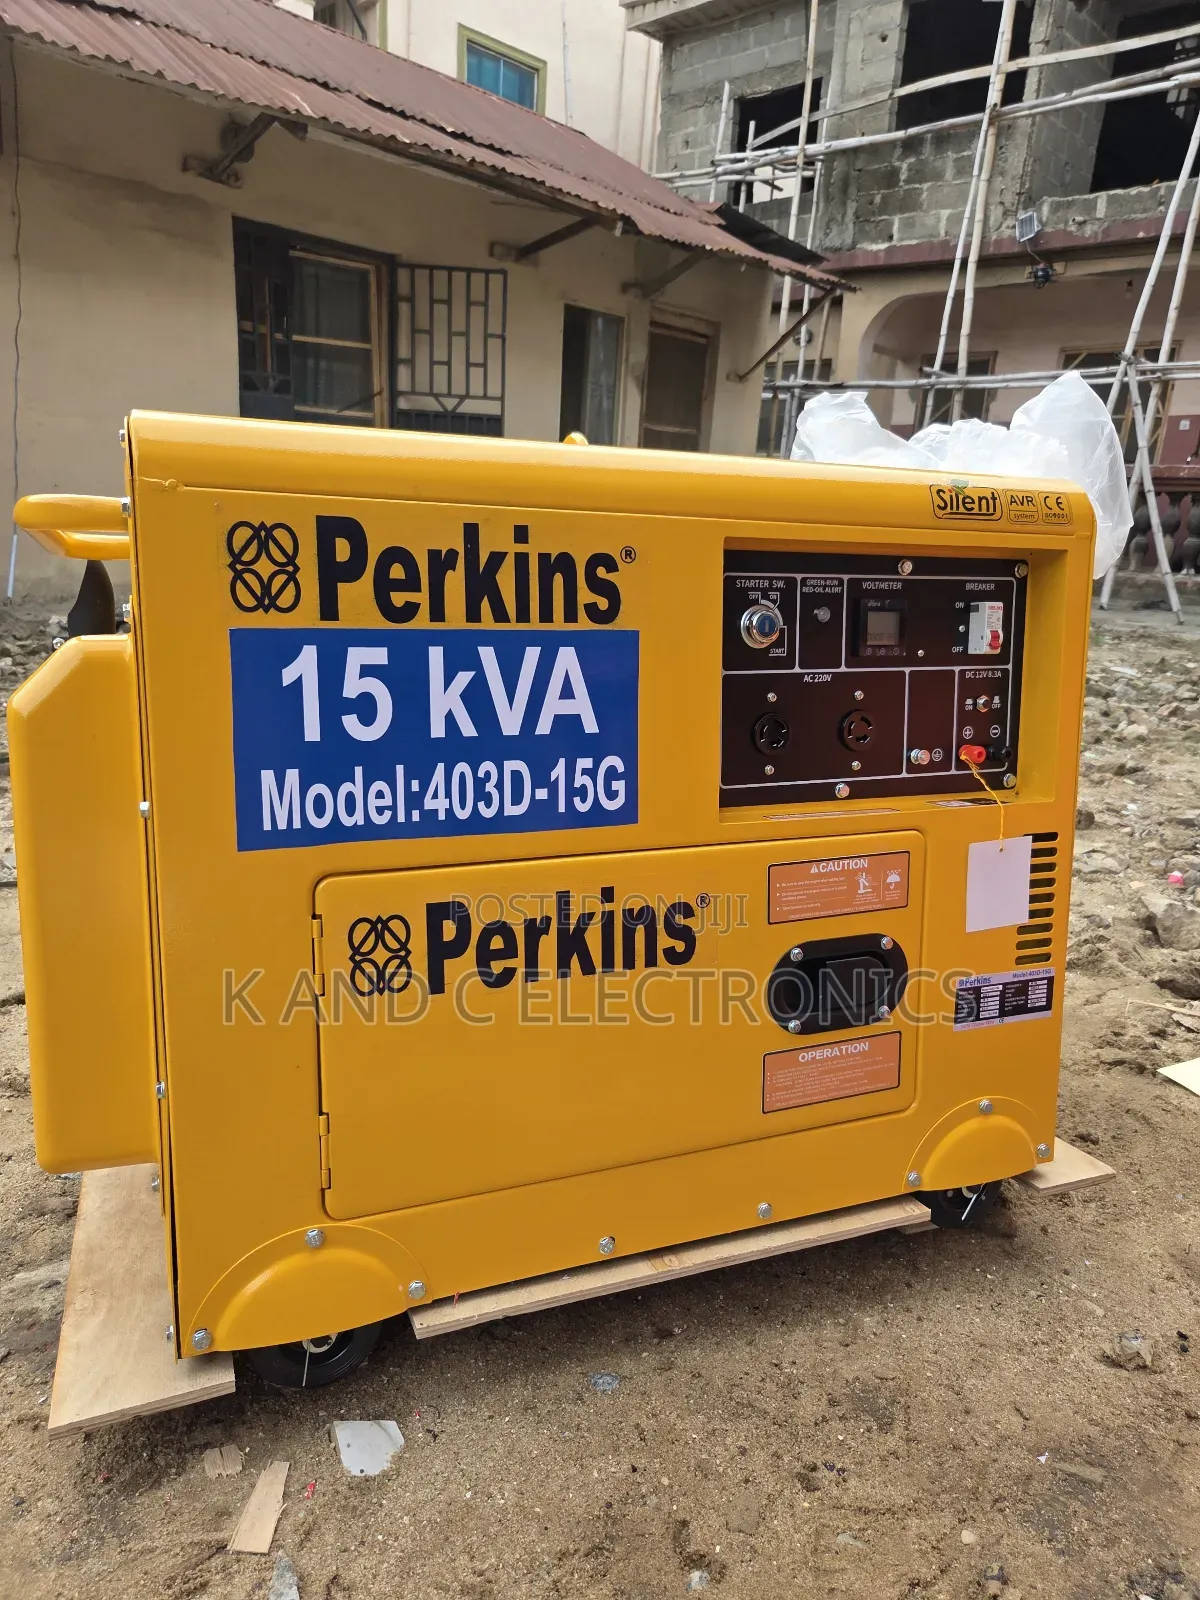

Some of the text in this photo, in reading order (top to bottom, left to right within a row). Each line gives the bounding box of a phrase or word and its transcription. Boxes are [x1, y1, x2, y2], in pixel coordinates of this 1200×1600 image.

[936, 488, 998, 513] Silent
[1010, 494, 1036, 507] AVR
[1043, 495, 1065, 512] CE
[1013, 512, 1035, 521] system
[736, 579, 786, 589] STARTER SW.
[862, 581, 902, 590] VOLTMETER
[965, 583, 995, 591] BREAKER
[803, 673, 832, 683] AC 220V
[965, 671, 975, 679] DC
[988, 670, 1002, 678] 8.3A
[281, 644, 600, 742] 15 kVA
[260, 755, 627, 832] Model:403D-15G
[819, 858, 868, 873] CAUTION
[798, 1041, 869, 1063] OPERATION
